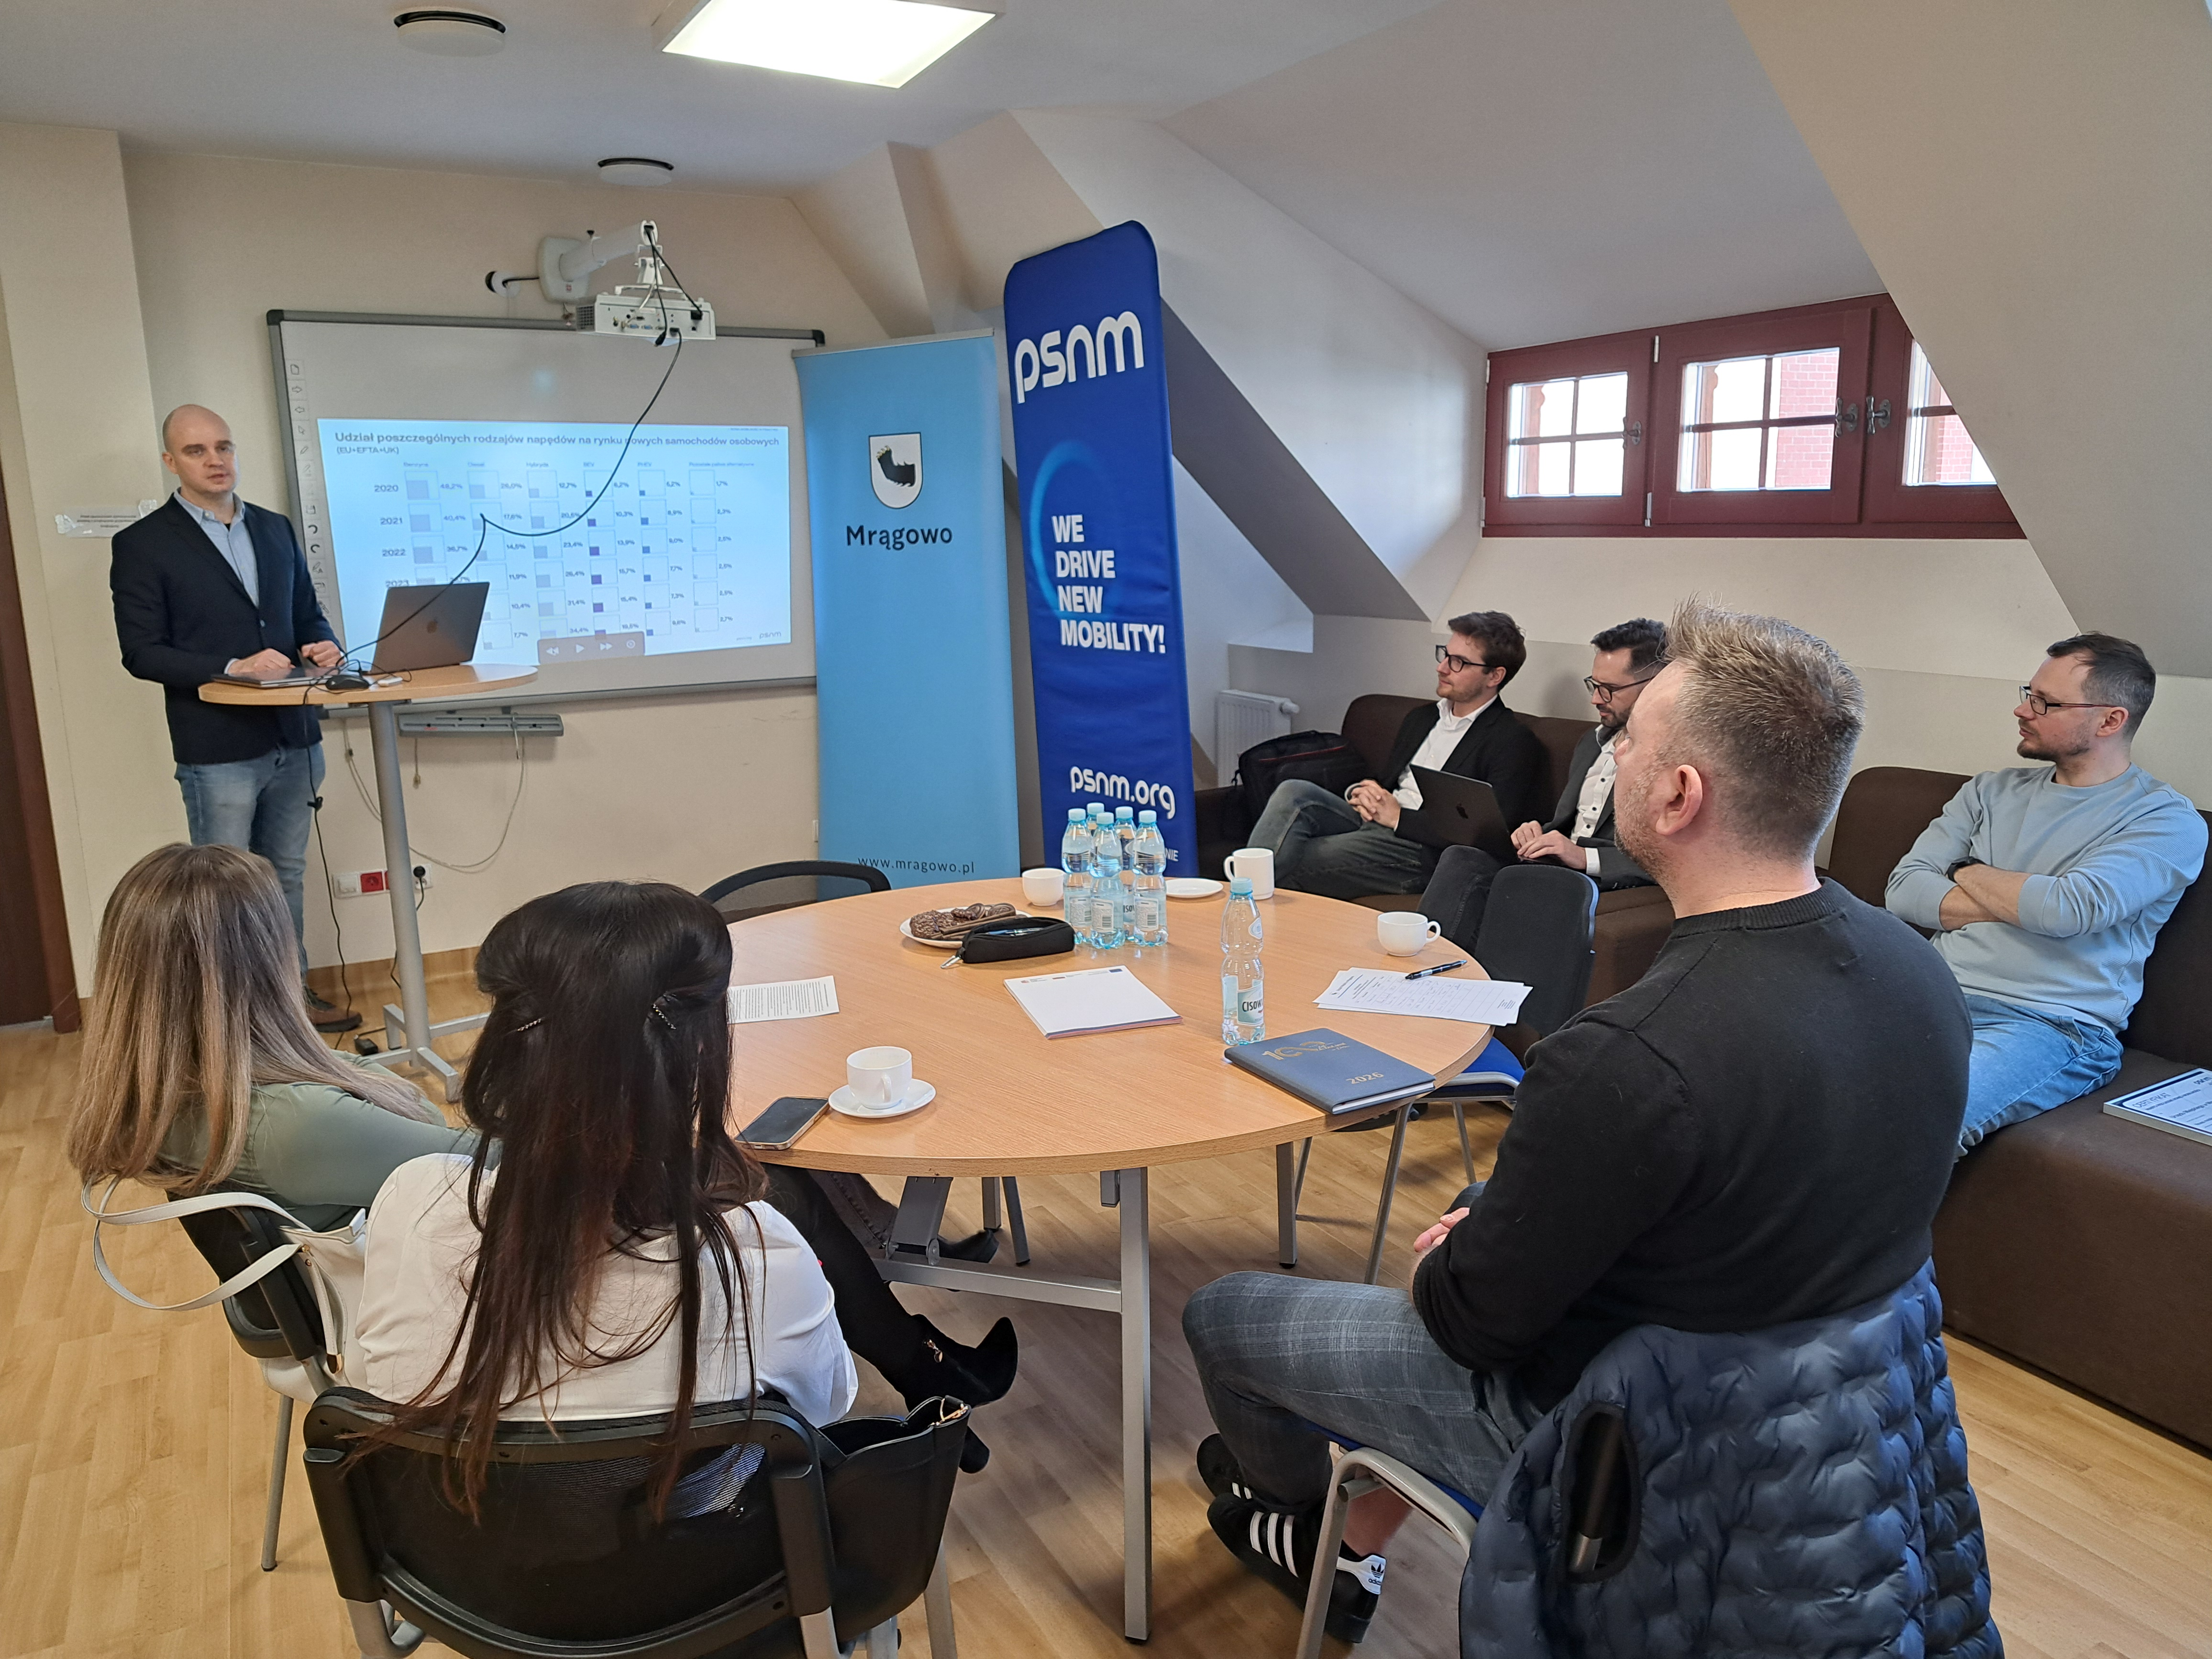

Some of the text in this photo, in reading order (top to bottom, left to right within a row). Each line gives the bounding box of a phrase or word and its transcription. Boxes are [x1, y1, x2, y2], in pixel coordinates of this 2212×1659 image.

[1014, 311, 1144, 404] psnm
[335, 432, 374, 442] Udział
[377, 433, 471, 445] poszczególnych
[473, 434, 524, 445] rodzajów
[527, 435, 576, 446] napędów
[594, 436, 622, 446] rynku
[665, 437, 727, 445] samochodów
[729, 437, 779, 447] osobowych
[374, 484, 399, 493] 2020
[380, 517, 403, 525] 2021
[1052, 514, 1084, 542] WE
[846, 525, 953, 551] Mrągowo
[382, 548, 406, 557] 2022
[1056, 550, 1116, 578] DRIVE
[1057, 585, 1103, 613] NEW
[759, 631, 782, 640] psnm
[1060, 619, 1166, 653] MOBILITY!
[1070, 766, 1176, 819] psnm.org
[858, 857, 974, 875] www.mragowo.pl
[1242, 999, 1263, 1012] CISOW
[1345, 1072, 1384, 1084] 2026
